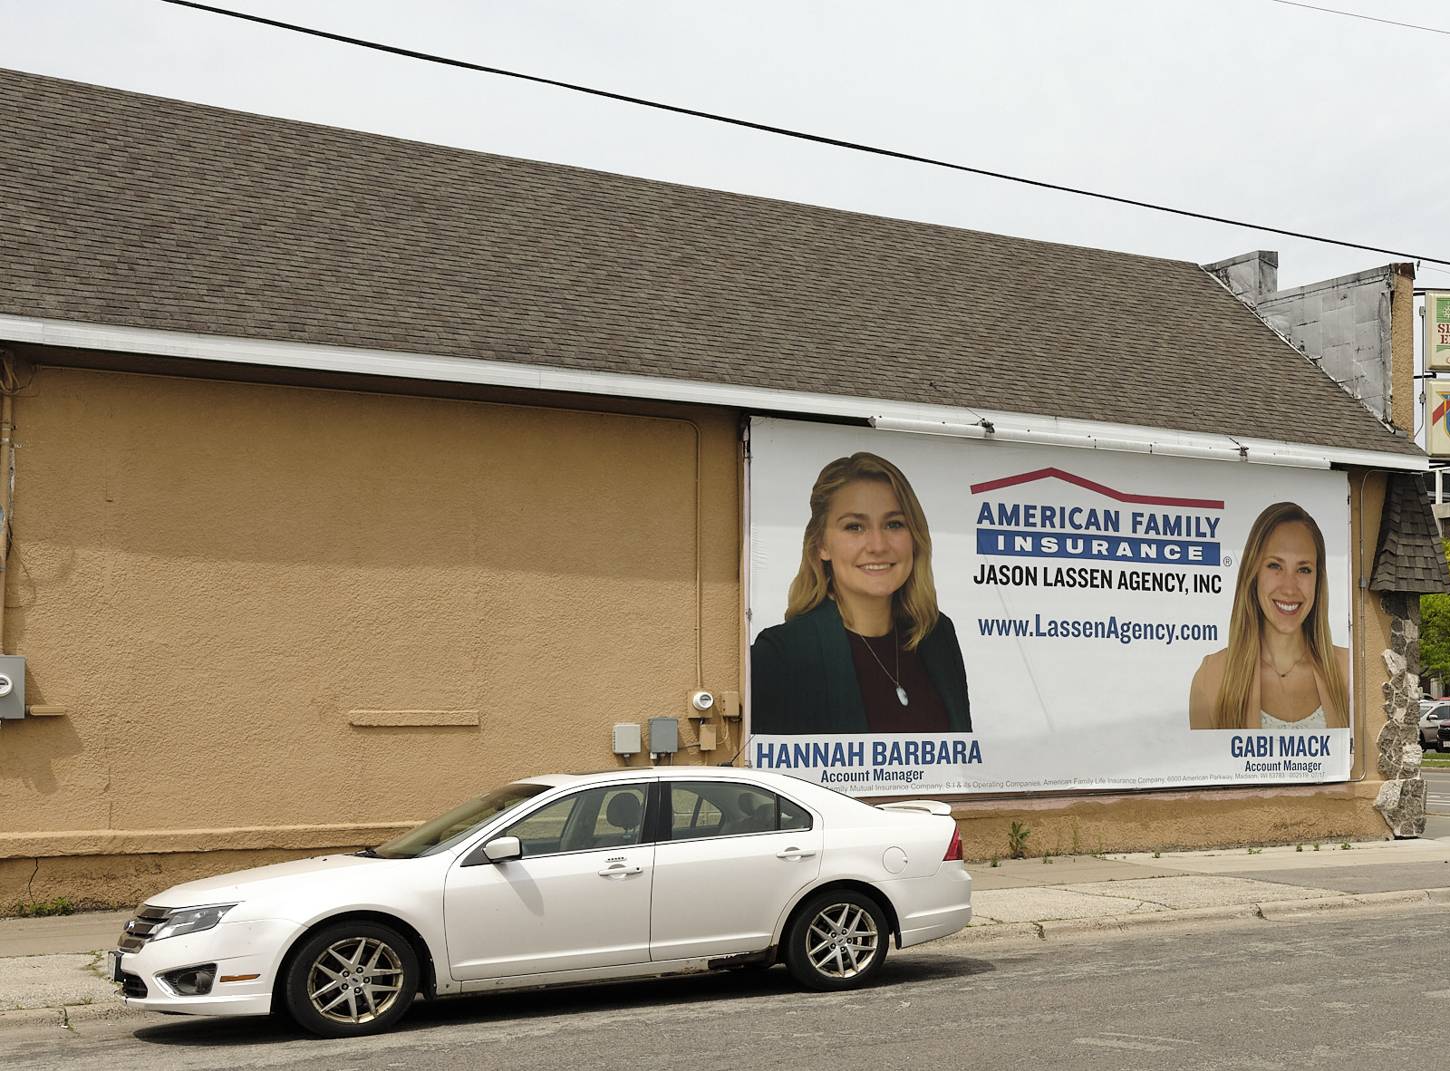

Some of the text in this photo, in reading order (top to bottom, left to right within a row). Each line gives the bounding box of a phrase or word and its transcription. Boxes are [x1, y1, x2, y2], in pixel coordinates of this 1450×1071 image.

[977, 501, 1221, 538] AMERICAN FAMILY
[997, 535, 1203, 560] INSURANCE
[973, 564, 1222, 595] JASON LASSEN AGENCY, INC
[978, 613, 1218, 645] www.LassenAgency.com
[756, 740, 983, 769] HANNAH BARBARA
[1231, 735, 1330, 758] GABI MACK
[821, 768, 925, 783] Account Manager
[1245, 760, 1322, 773] Account Manager
[850, 784, 874, 792] Mutual
[972, 781, 1004, 790] Operating
[1043, 778, 1072, 786] American
[1073, 777, 1094, 786] Family
[1107, 776, 1137, 784] Insurance
